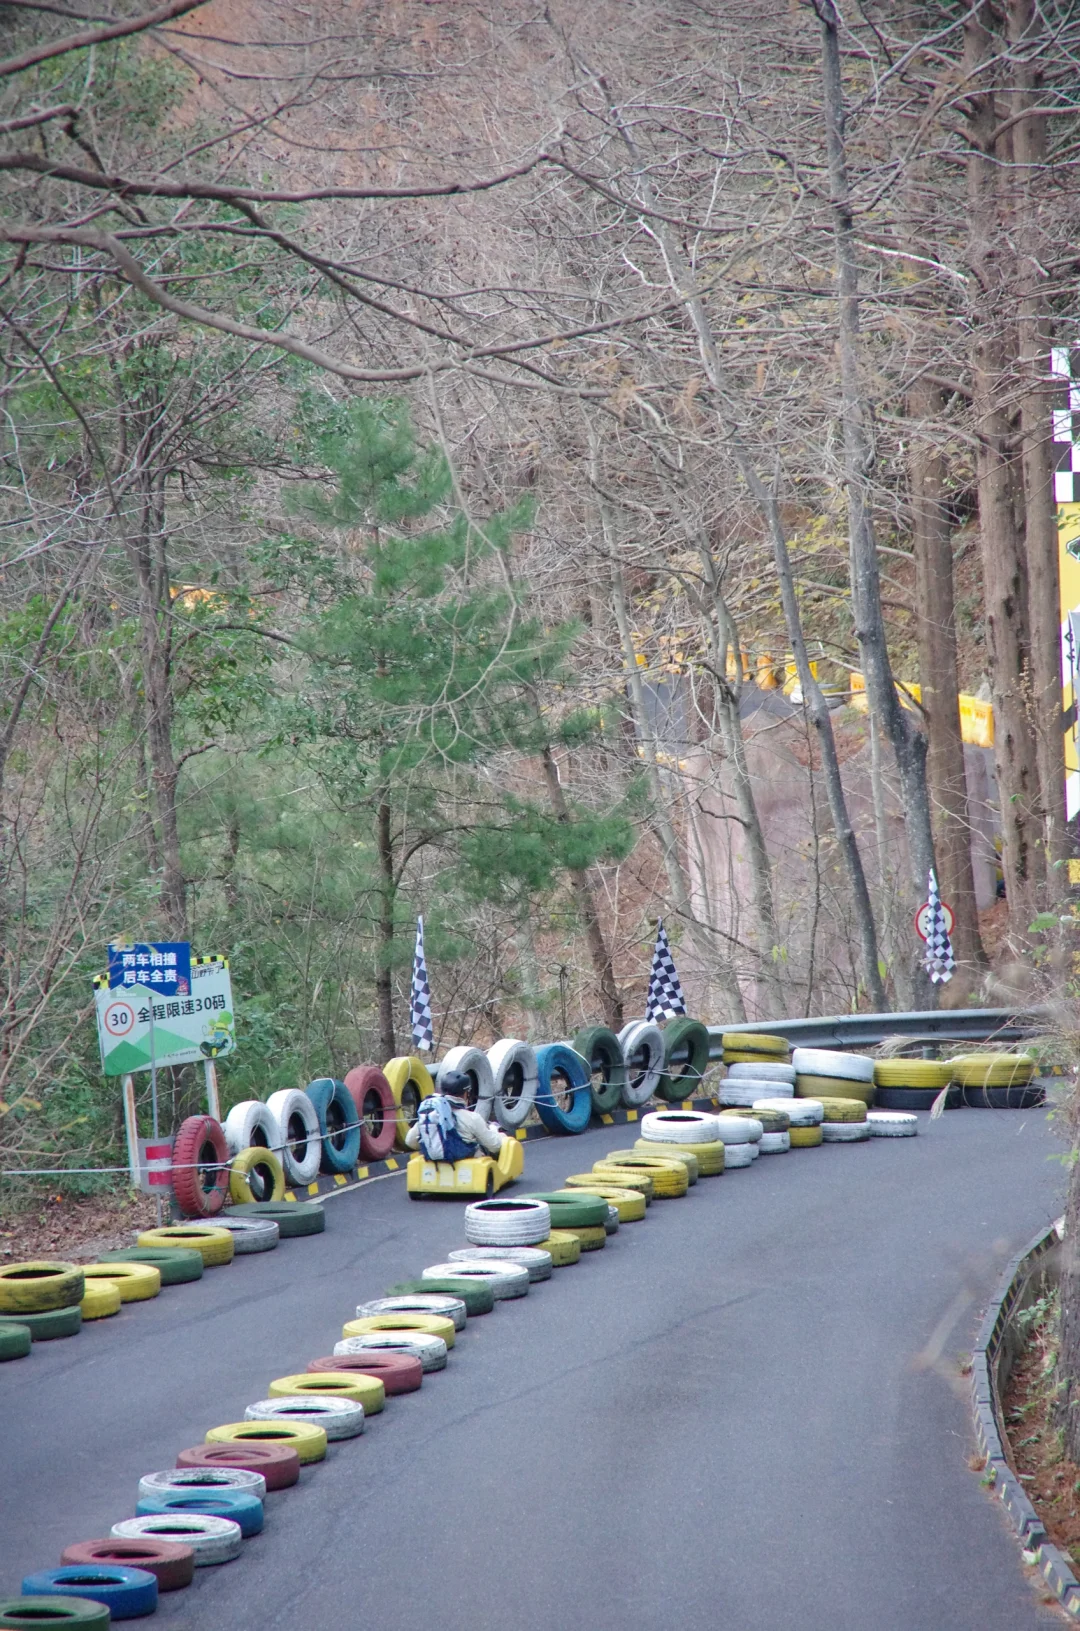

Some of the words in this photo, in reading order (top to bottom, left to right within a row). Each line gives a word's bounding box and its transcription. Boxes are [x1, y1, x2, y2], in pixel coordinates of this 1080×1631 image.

[122, 952, 177, 967] 两车相撞
[123, 969, 177, 984] 后车全责
[137, 994, 226, 1024] 全程限速30码
[111, 1012, 128, 1026] 30
